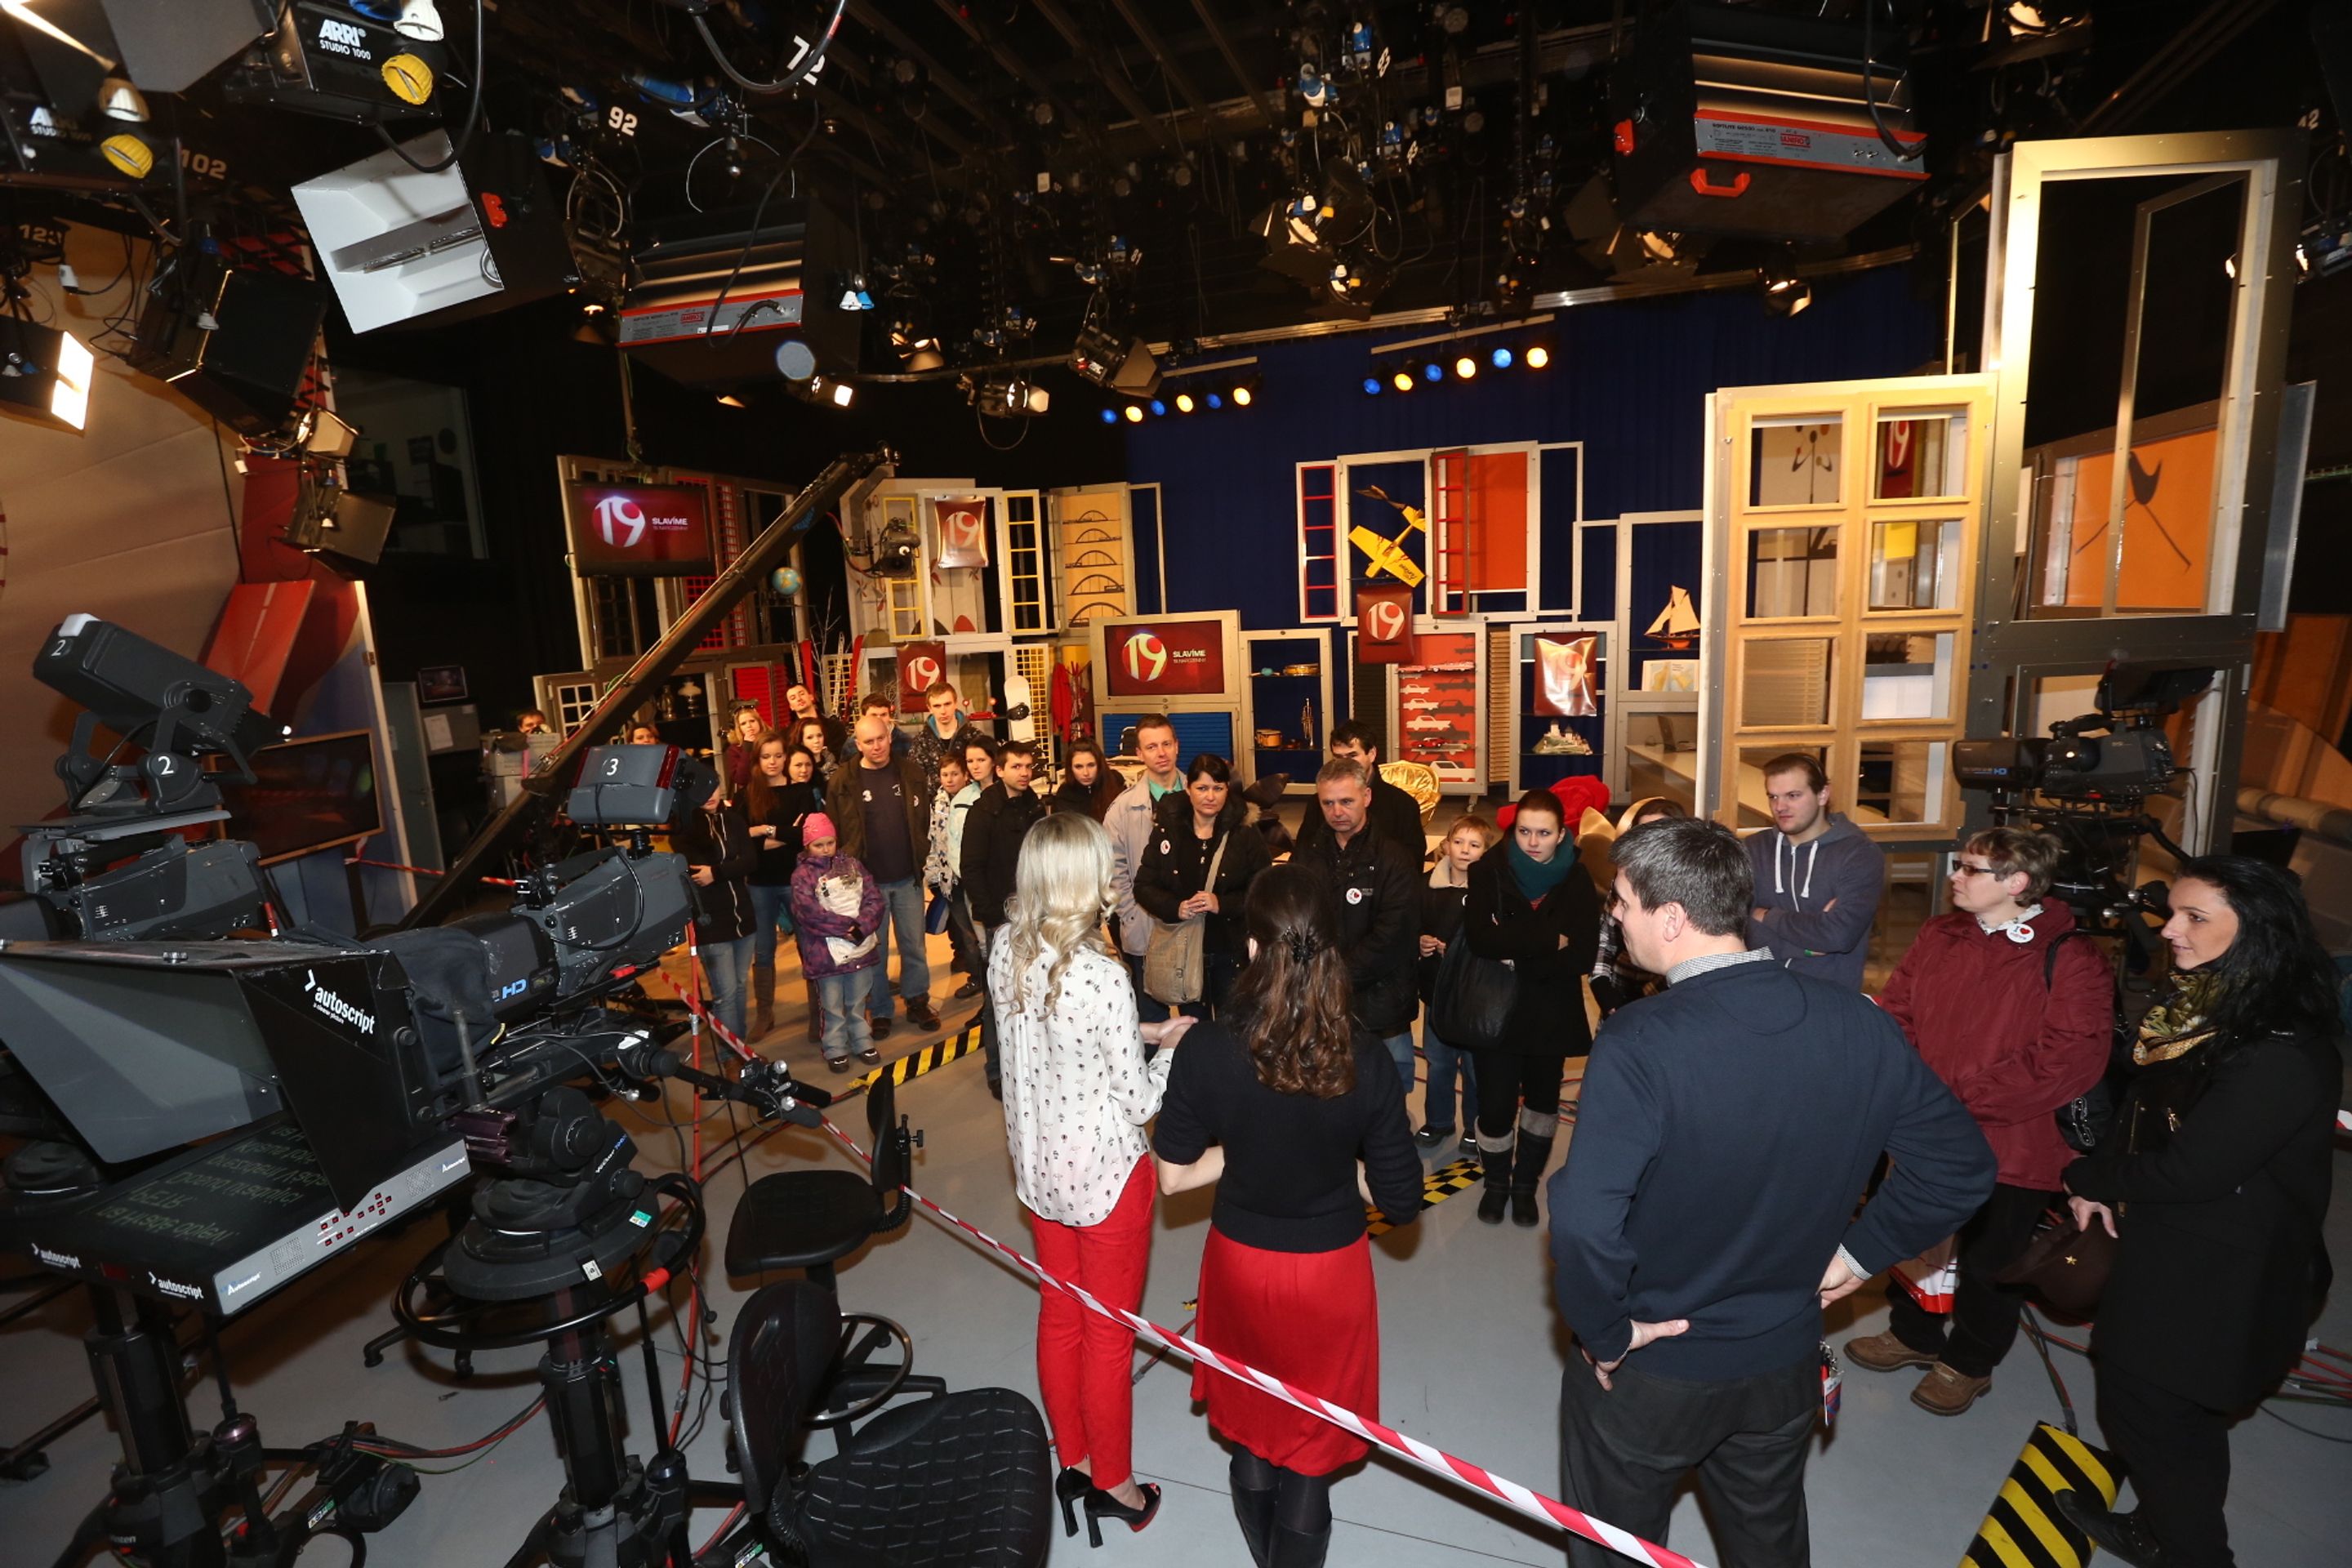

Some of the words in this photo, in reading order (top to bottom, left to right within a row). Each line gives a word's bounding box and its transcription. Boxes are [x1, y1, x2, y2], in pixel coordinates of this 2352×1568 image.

[319, 39, 350, 55] STUDIO
[352, 47, 372, 60] 1000
[786, 35, 826, 85] 72
[608, 106, 639, 136] 92
[181, 149, 227, 180] 102
[595, 496, 645, 547] 19
[652, 515, 688, 526] SLAVÍME
[945, 511, 979, 547] 19
[1367, 602, 1405, 640] 19
[51, 639, 66, 657] 2
[1124, 633, 1167, 681] 19
[1173, 648, 1206, 658] SLAVÍME
[906, 657, 940, 693] 19
[158, 755, 174, 775] 2
[606, 758, 619, 776] 3
[502, 978, 528, 1000] HD
[314, 986, 376, 1035] autoscript
[41, 1249, 82, 1269] autoscript
[158, 1277, 204, 1299] autoscript
